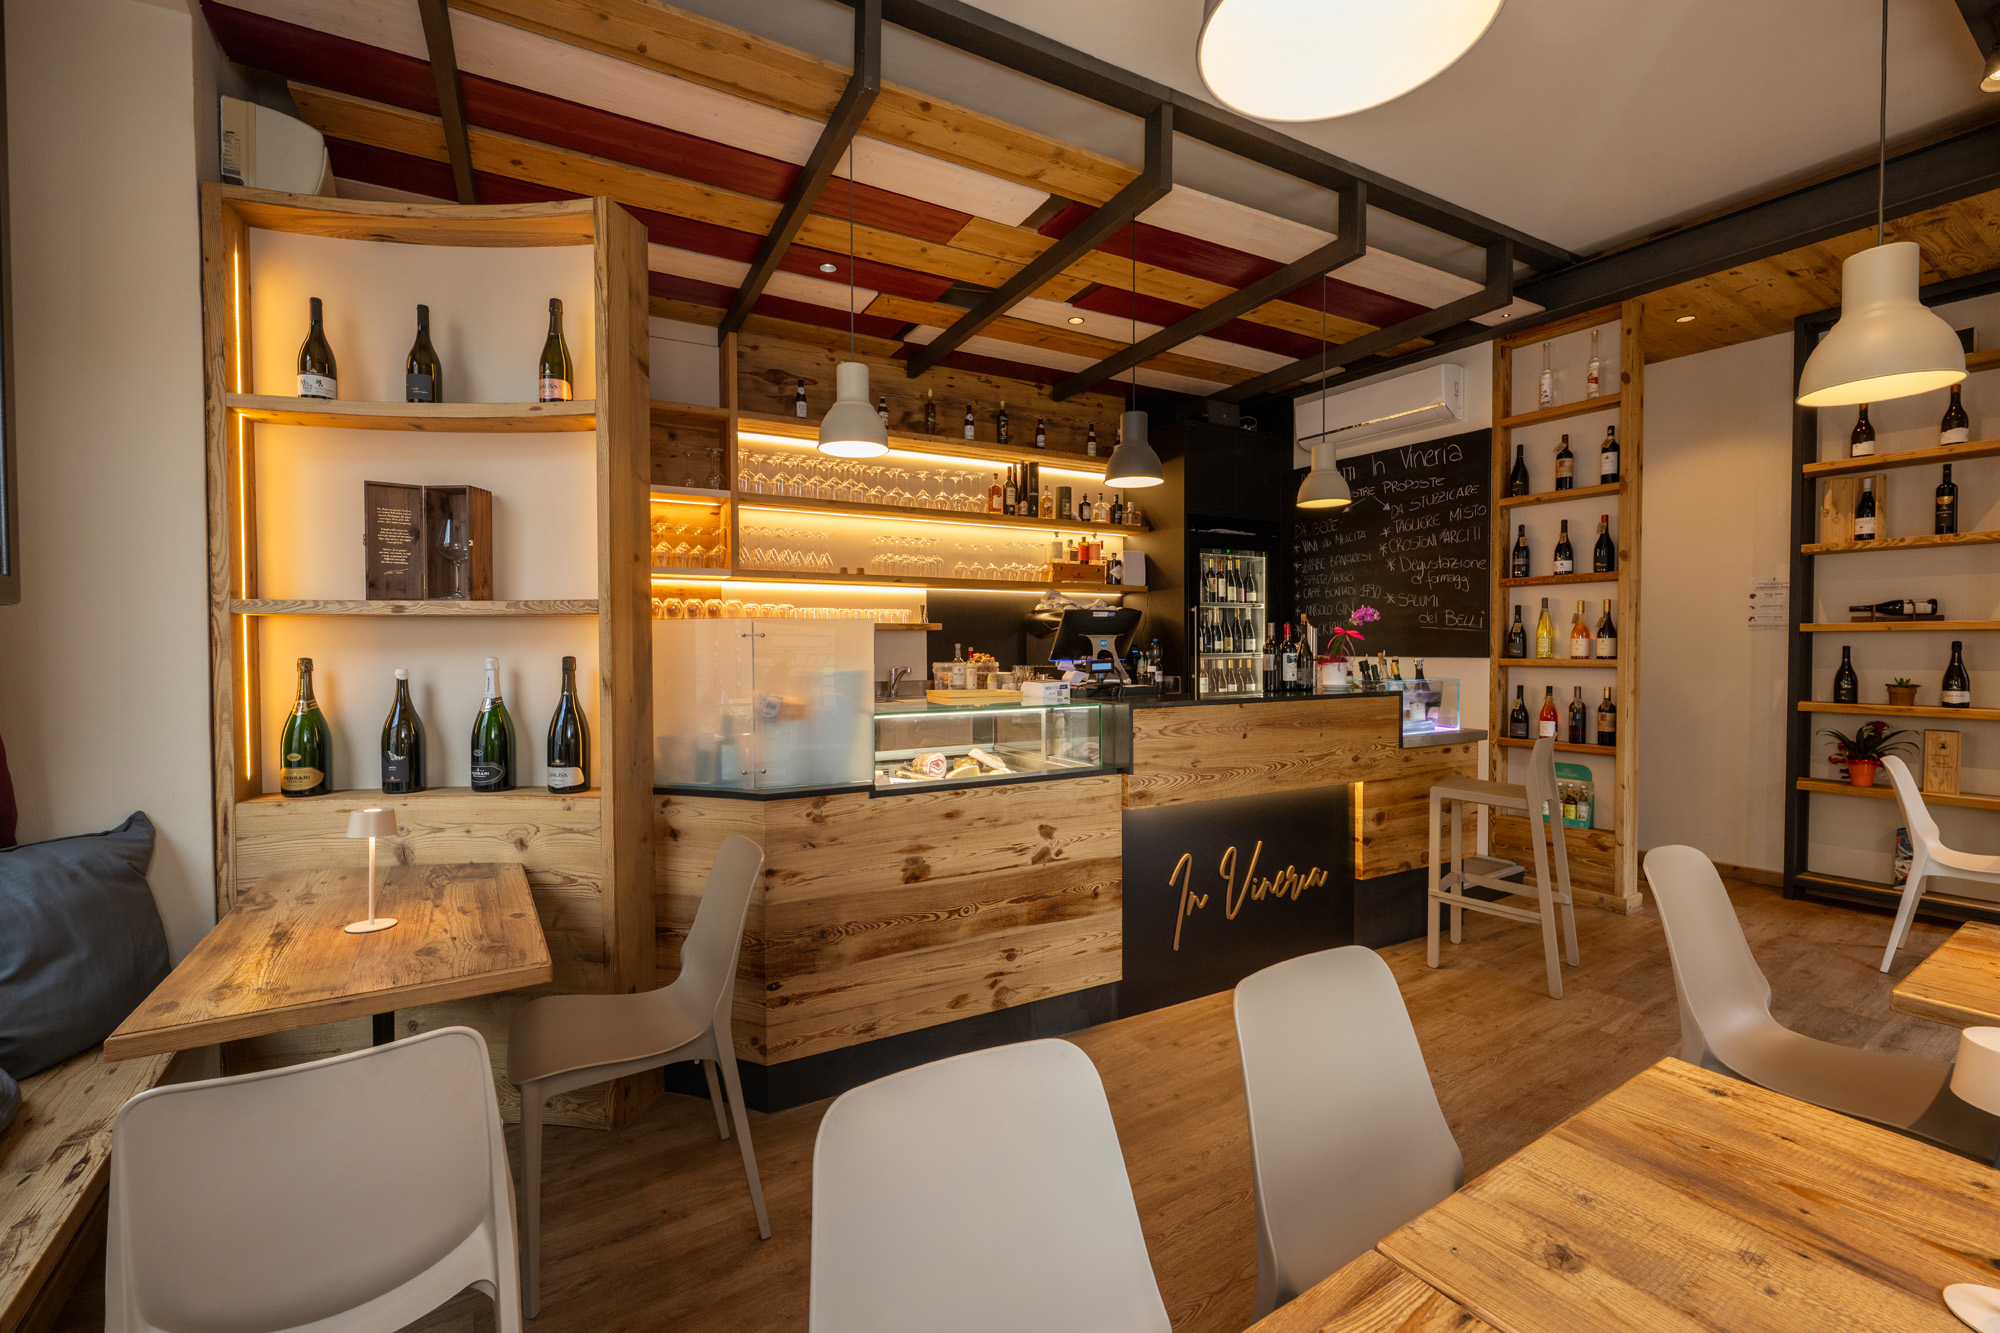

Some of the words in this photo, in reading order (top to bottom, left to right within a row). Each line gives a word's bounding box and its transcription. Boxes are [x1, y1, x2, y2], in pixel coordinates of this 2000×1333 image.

[1400, 443, 1463, 469] Vineria
[1382, 476, 1446, 494] PROPOSTE
[1390, 503, 1404, 520] DA
[1408, 484, 1480, 512] STUZZICARE
[1392, 513, 1441, 534] TAGLIERE
[1449, 503, 1488, 522] MISTO
[1301, 539, 1319, 553] VINI
[1388, 532, 1438, 554] CROSTONI
[1329, 552, 1372, 568] BAVARESI
[1399, 554, 1487, 578] Degustazione
[1324, 585, 1357, 599] BONTADI
[1360, 583, 1382, 600] 1790
[1397, 592, 1439, 608] SALUMI
[1305, 602, 1333, 617] ANGOLO
[1418, 610, 1438, 624] del
[1168, 853, 1209, 951] In
[1219, 840, 1329, 920] Vineria
